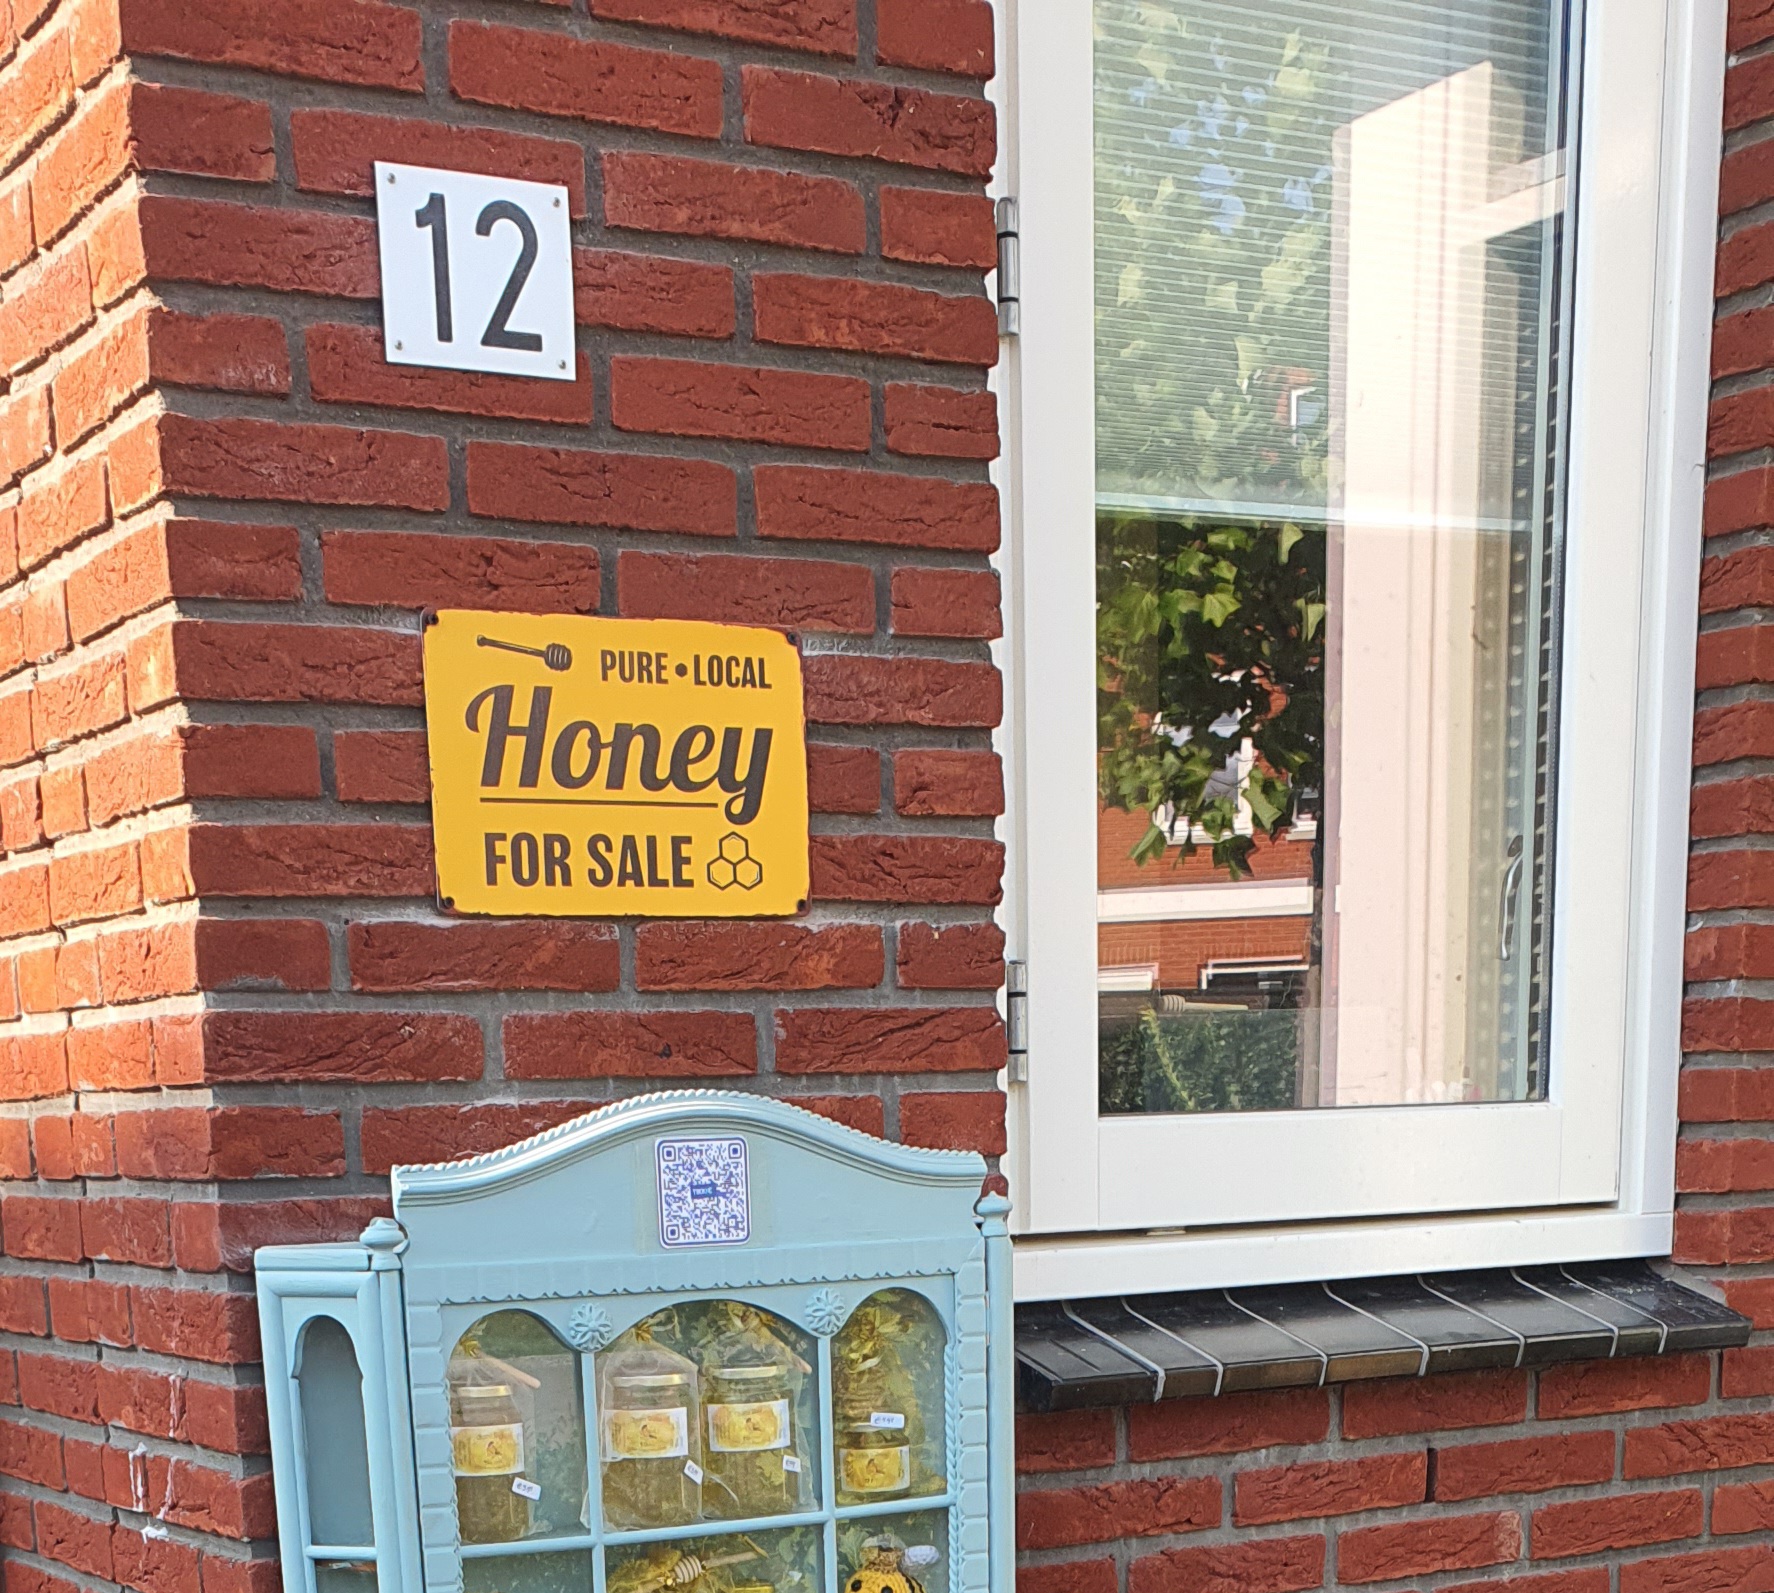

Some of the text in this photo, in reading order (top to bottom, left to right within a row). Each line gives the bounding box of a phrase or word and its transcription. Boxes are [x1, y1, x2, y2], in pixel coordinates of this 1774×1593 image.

[414, 192, 543, 353] 12
[600, 649, 773, 689] PURE LOCAL
[465, 684, 774, 826] Honey
[484, 831, 695, 889] FOR SALE
